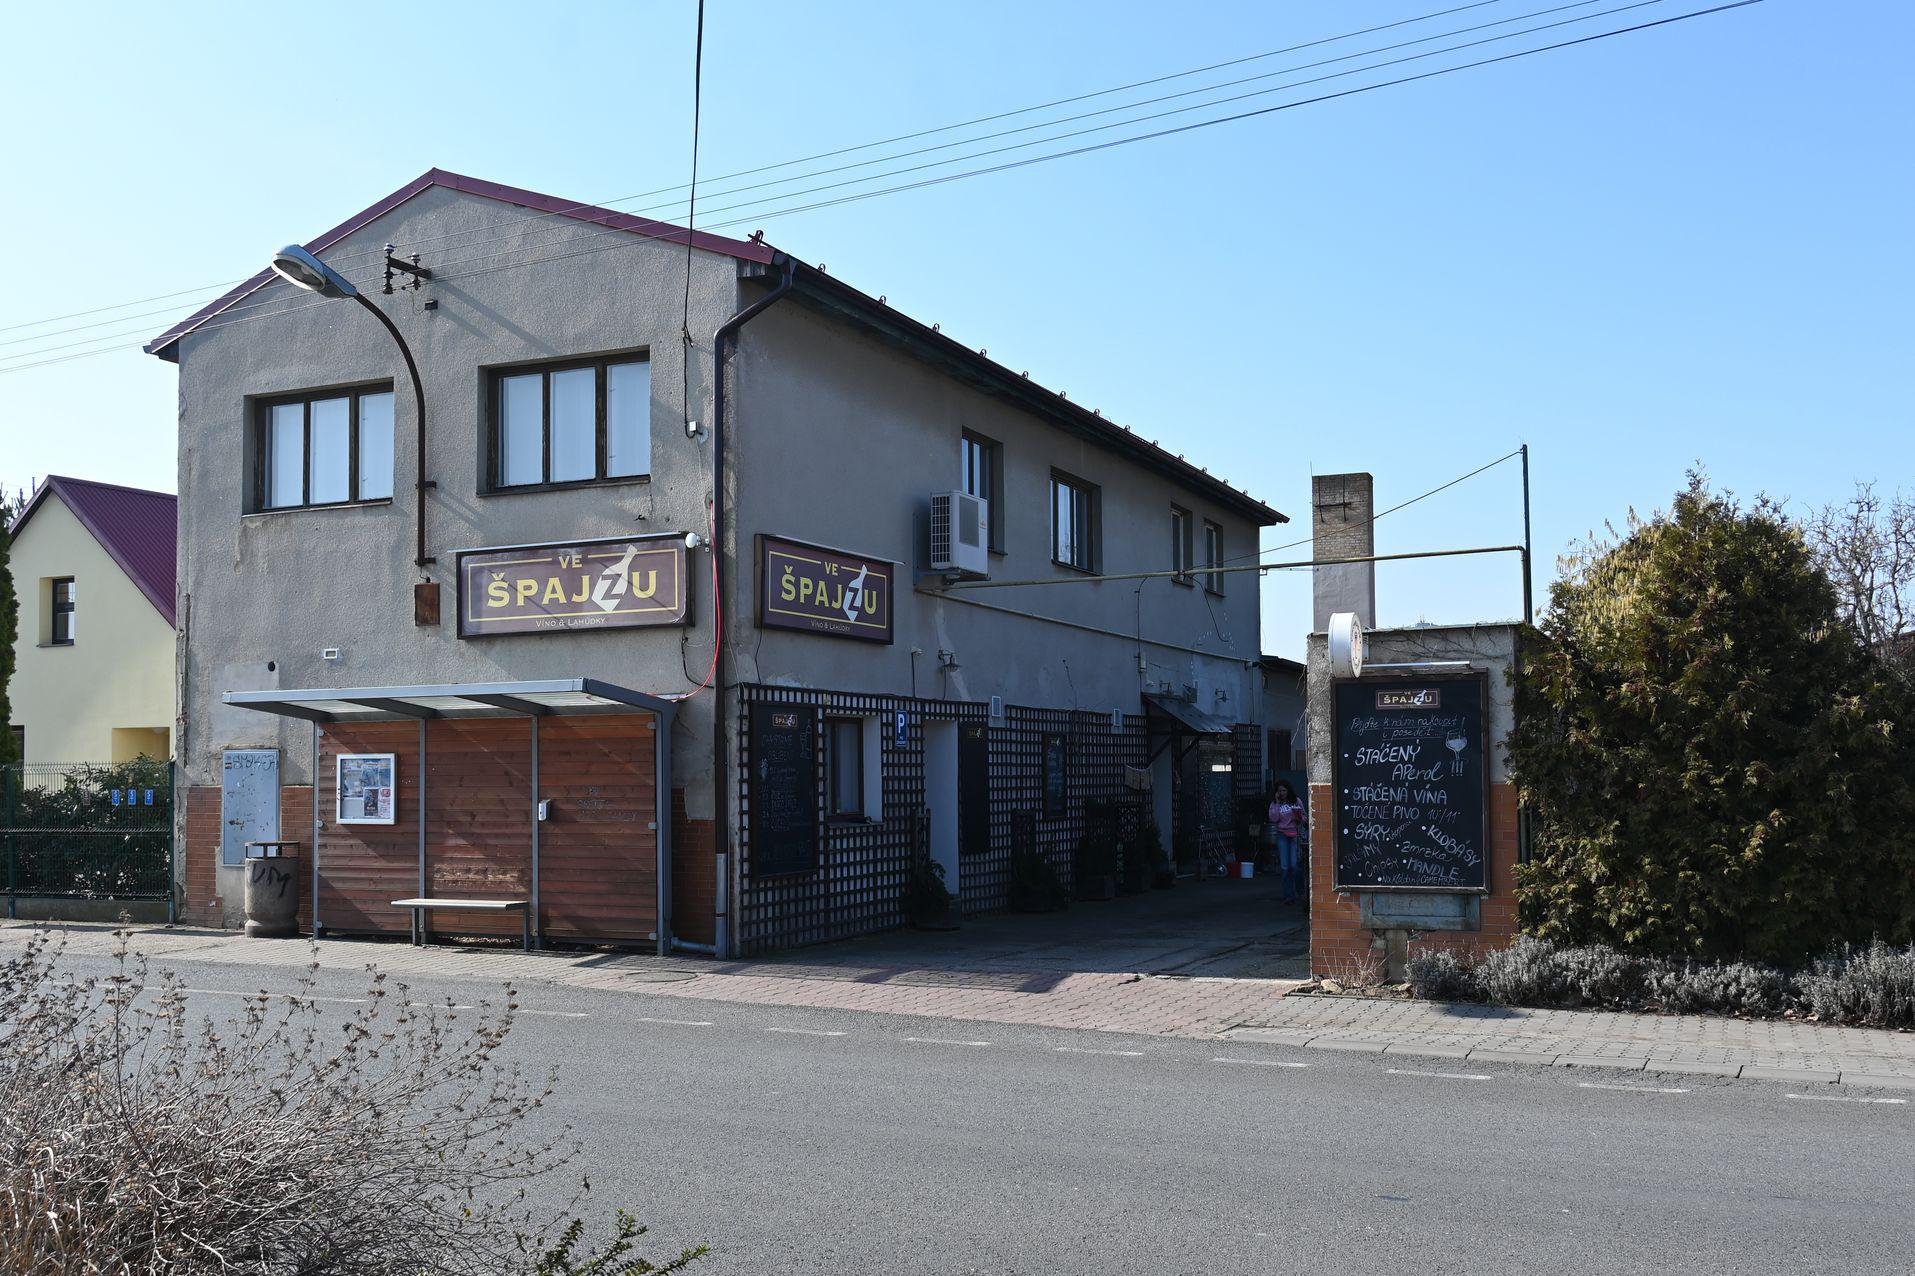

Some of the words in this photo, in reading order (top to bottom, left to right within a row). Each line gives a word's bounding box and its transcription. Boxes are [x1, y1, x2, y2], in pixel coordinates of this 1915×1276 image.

[558, 554, 582, 568] VE
[825, 562, 838, 576] VE
[487, 570, 657, 608] ŠPAJZU
[780, 564, 877, 615] ŠPAJZU
[1384, 694, 1432, 704] ŠPAJZU
[898, 714, 905, 734] P
[1354, 739, 1421, 766] STÁČENÝ
[1352, 782, 1409, 803] STÁČENÁ
[1413, 784, 1448, 805] VÍNA
[1393, 805, 1420, 820] PIVO
[1354, 822, 1390, 846] SÝRY
[1427, 824, 1481, 867] KLOBÁSY
[1407, 857, 1460, 880] MANDLE
